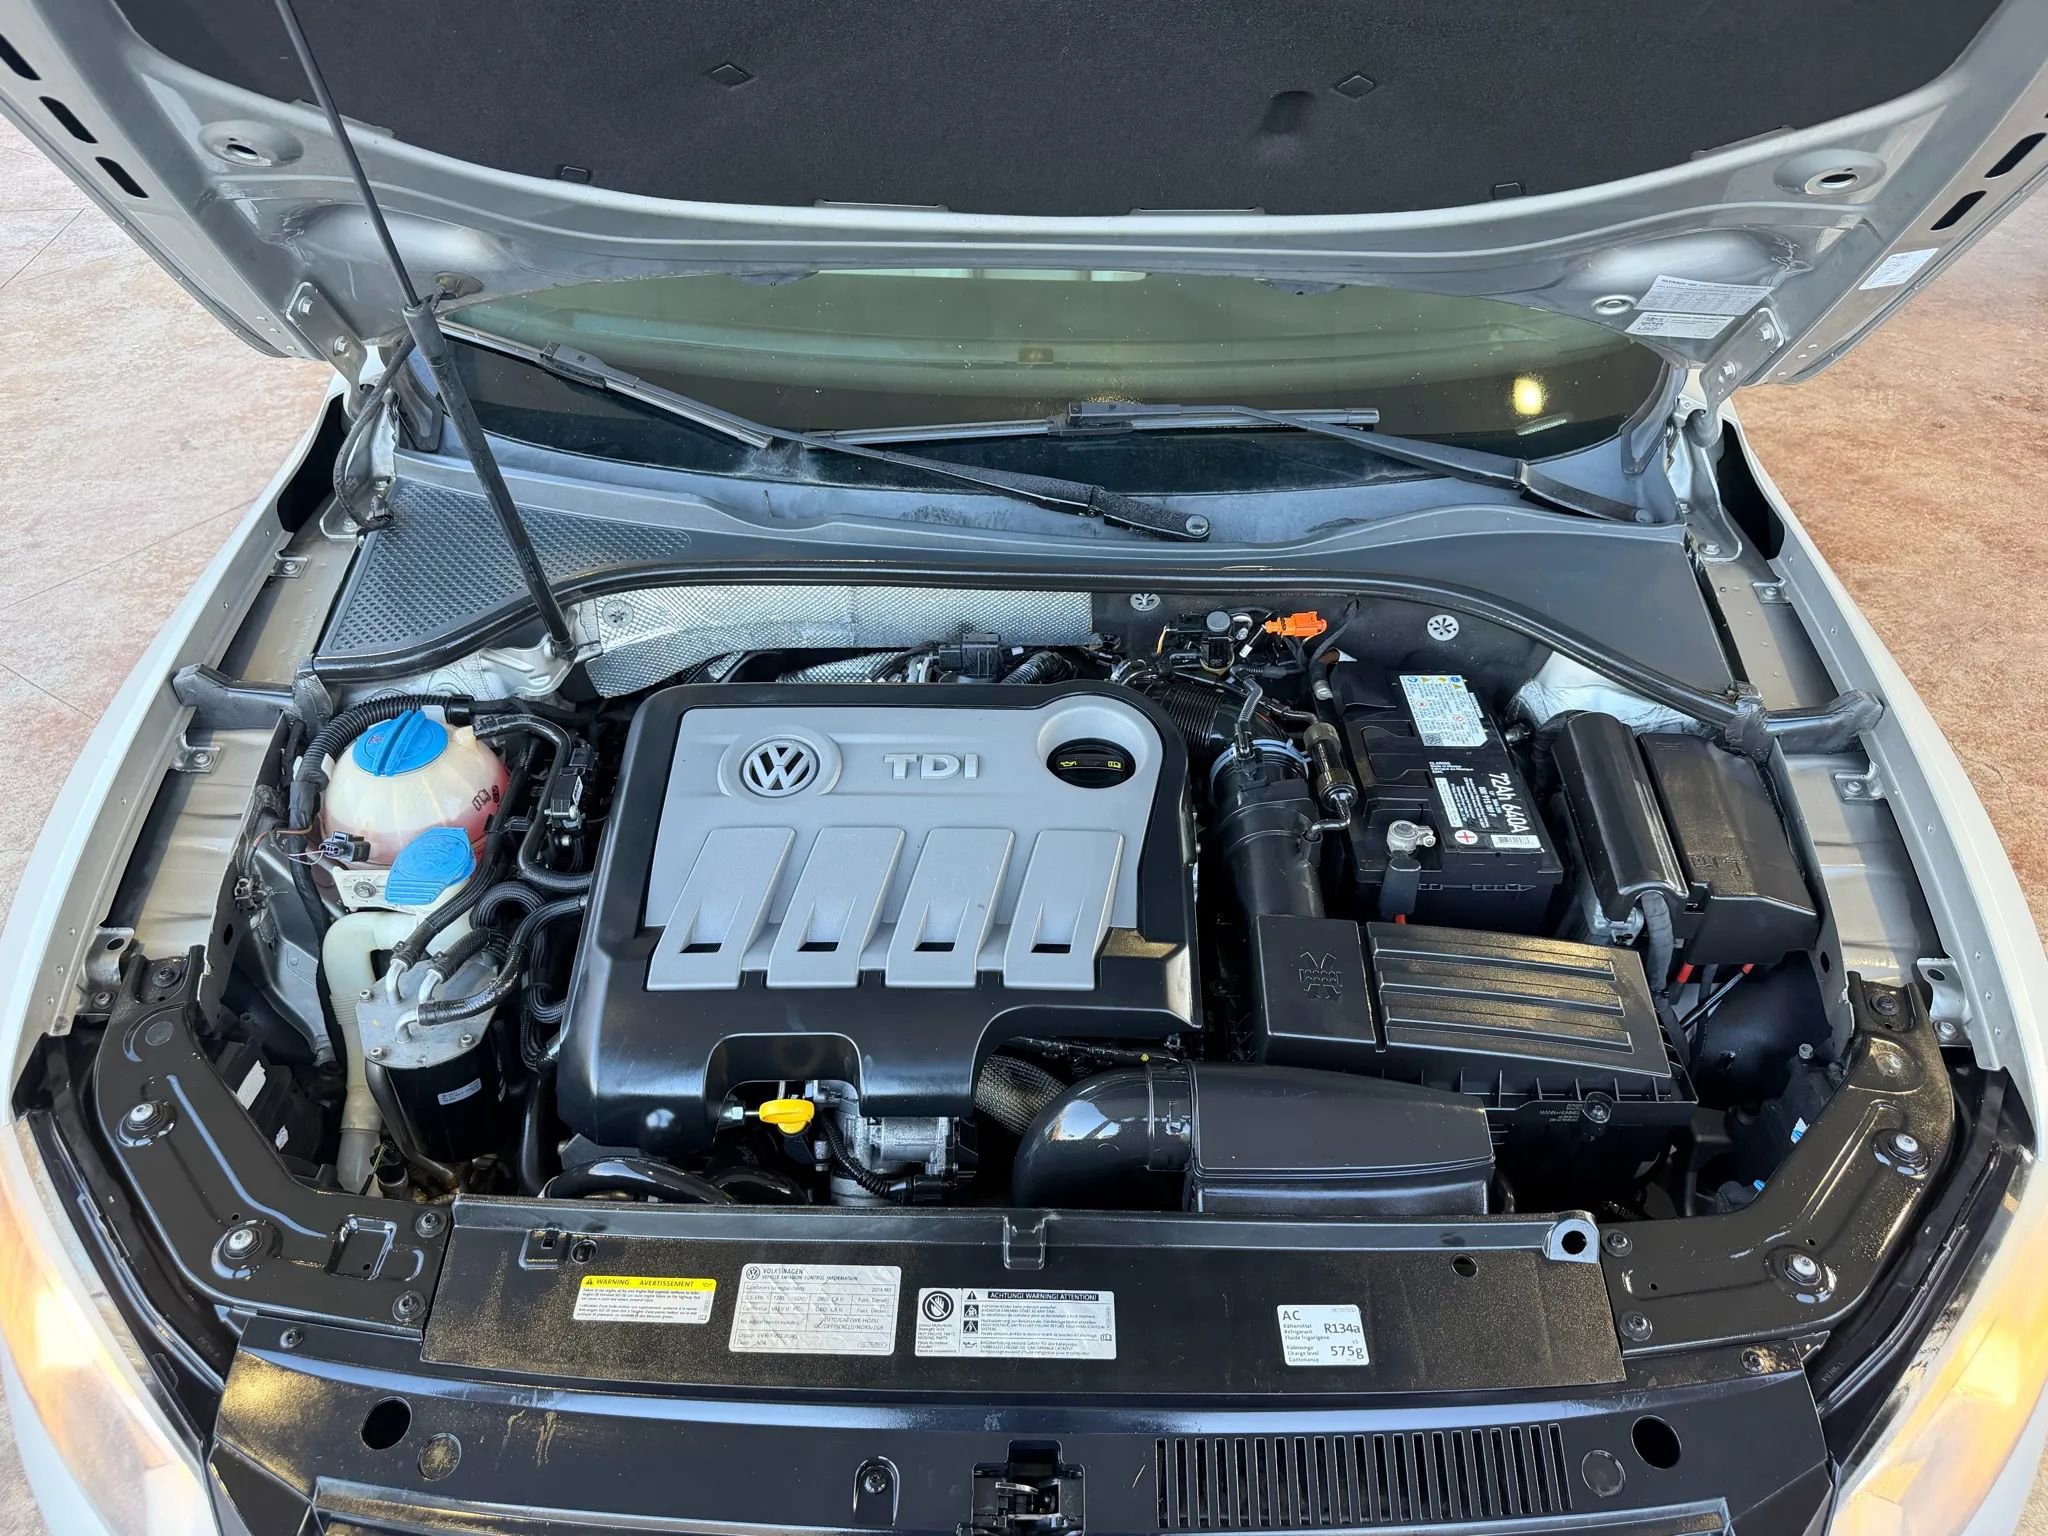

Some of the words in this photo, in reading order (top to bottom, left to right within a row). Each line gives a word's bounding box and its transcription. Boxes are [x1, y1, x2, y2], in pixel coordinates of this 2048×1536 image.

[883, 753, 980, 780] TDI
[1488, 772, 1517, 801] 72Ah
[1501, 803, 1530, 834] 640A
[1283, 1310, 1301, 1320] AC
[1324, 1323, 1361, 1334] R134a
[1330, 1346, 1364, 1359] 575g
